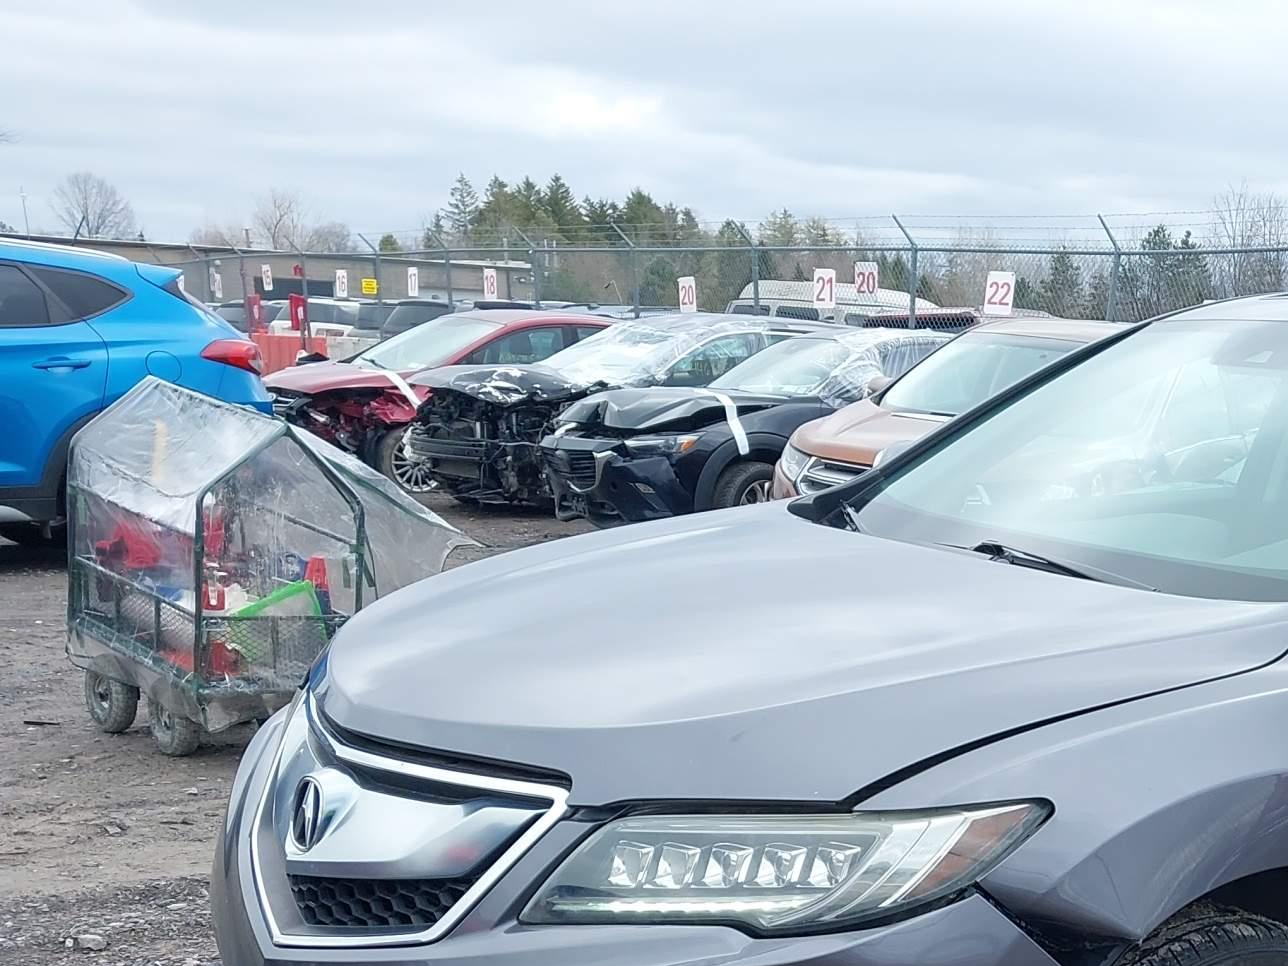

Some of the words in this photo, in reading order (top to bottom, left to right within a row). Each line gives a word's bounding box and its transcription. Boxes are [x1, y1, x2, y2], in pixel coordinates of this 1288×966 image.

[337, 275, 346, 292] 16
[409, 273, 417, 294] 17
[485, 275, 496, 295] 18
[816, 276, 833, 303] 21
[856, 272, 875, 294] 20
[987, 281, 1011, 306] 22
[680, 285, 695, 305] 20
